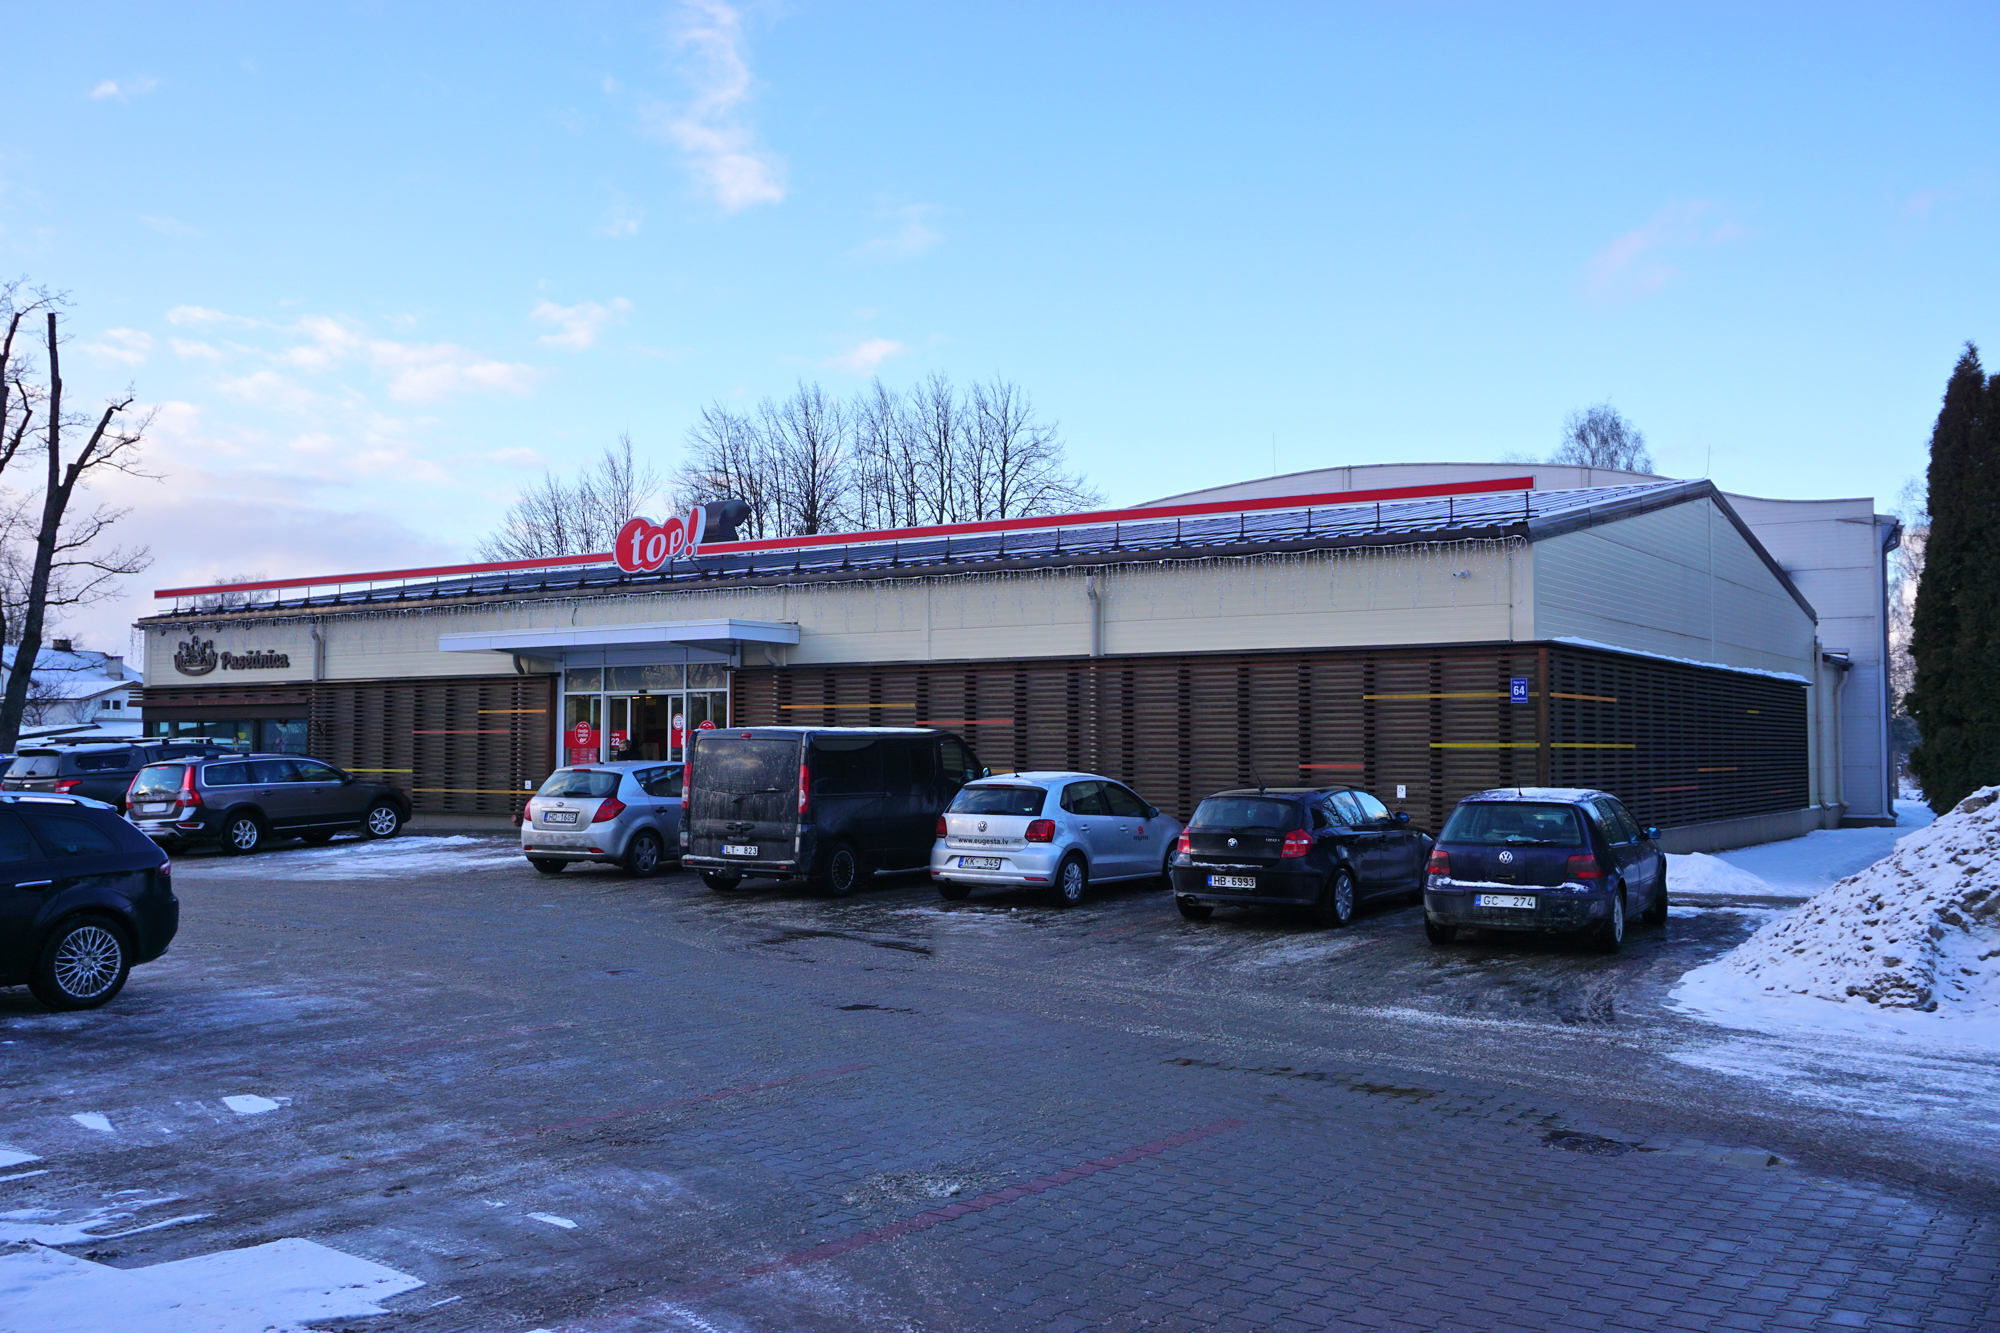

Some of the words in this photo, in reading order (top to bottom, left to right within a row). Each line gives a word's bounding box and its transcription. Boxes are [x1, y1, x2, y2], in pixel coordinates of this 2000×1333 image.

[631, 506, 699, 565] top!
[220, 649, 290, 670] Pasēdnīca
[1513, 685, 1525, 696] 64
[611, 738, 620, 746] 22
[548, 813, 575, 821] HD-1605
[958, 837, 1009, 846] www.eugesta.lv
[1213, 876, 1255, 887] HB-6993
